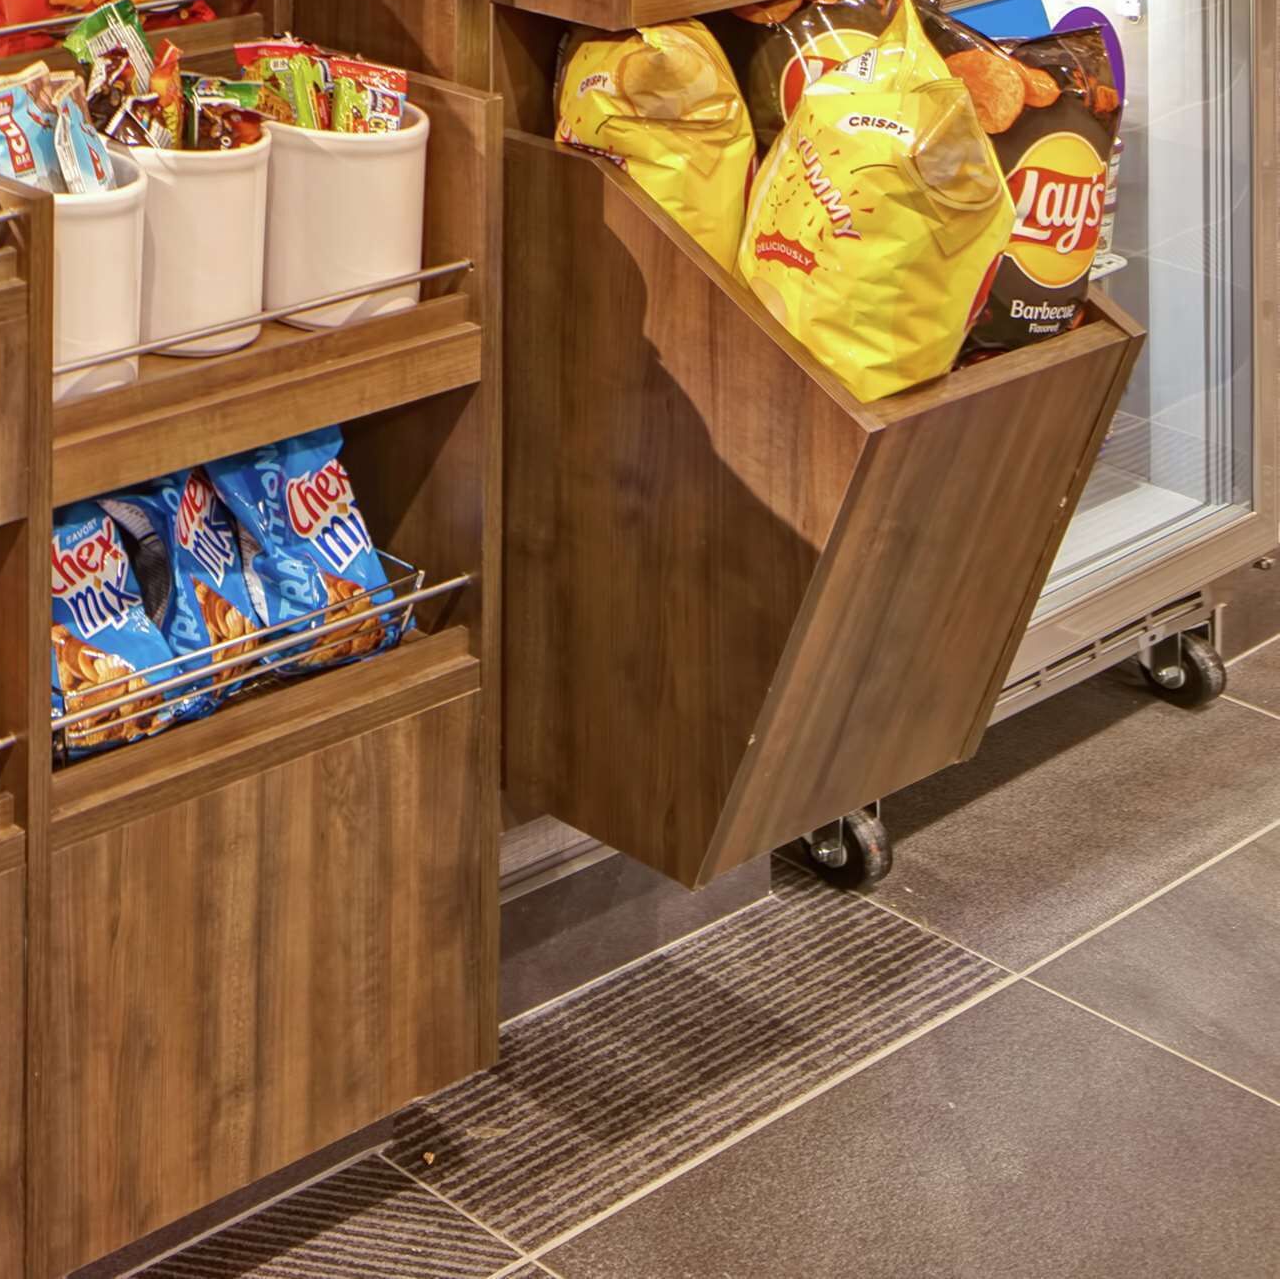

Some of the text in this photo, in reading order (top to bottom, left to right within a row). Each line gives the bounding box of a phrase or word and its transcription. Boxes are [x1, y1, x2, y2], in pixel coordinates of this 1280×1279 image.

[578, 72, 609, 93] CRISPY
[847, 113, 910, 138] CRISPY
[796, 133, 864, 242] YUMMY
[1014, 169, 1104, 256] Lay's
[755, 240, 814, 269] DELICIOUSLY
[1009, 298, 1075, 322] Barbecue
[286, 458, 351, 536] Chex
[65, 517, 98, 545] SAVORY
[68, 561, 140, 634] mix
